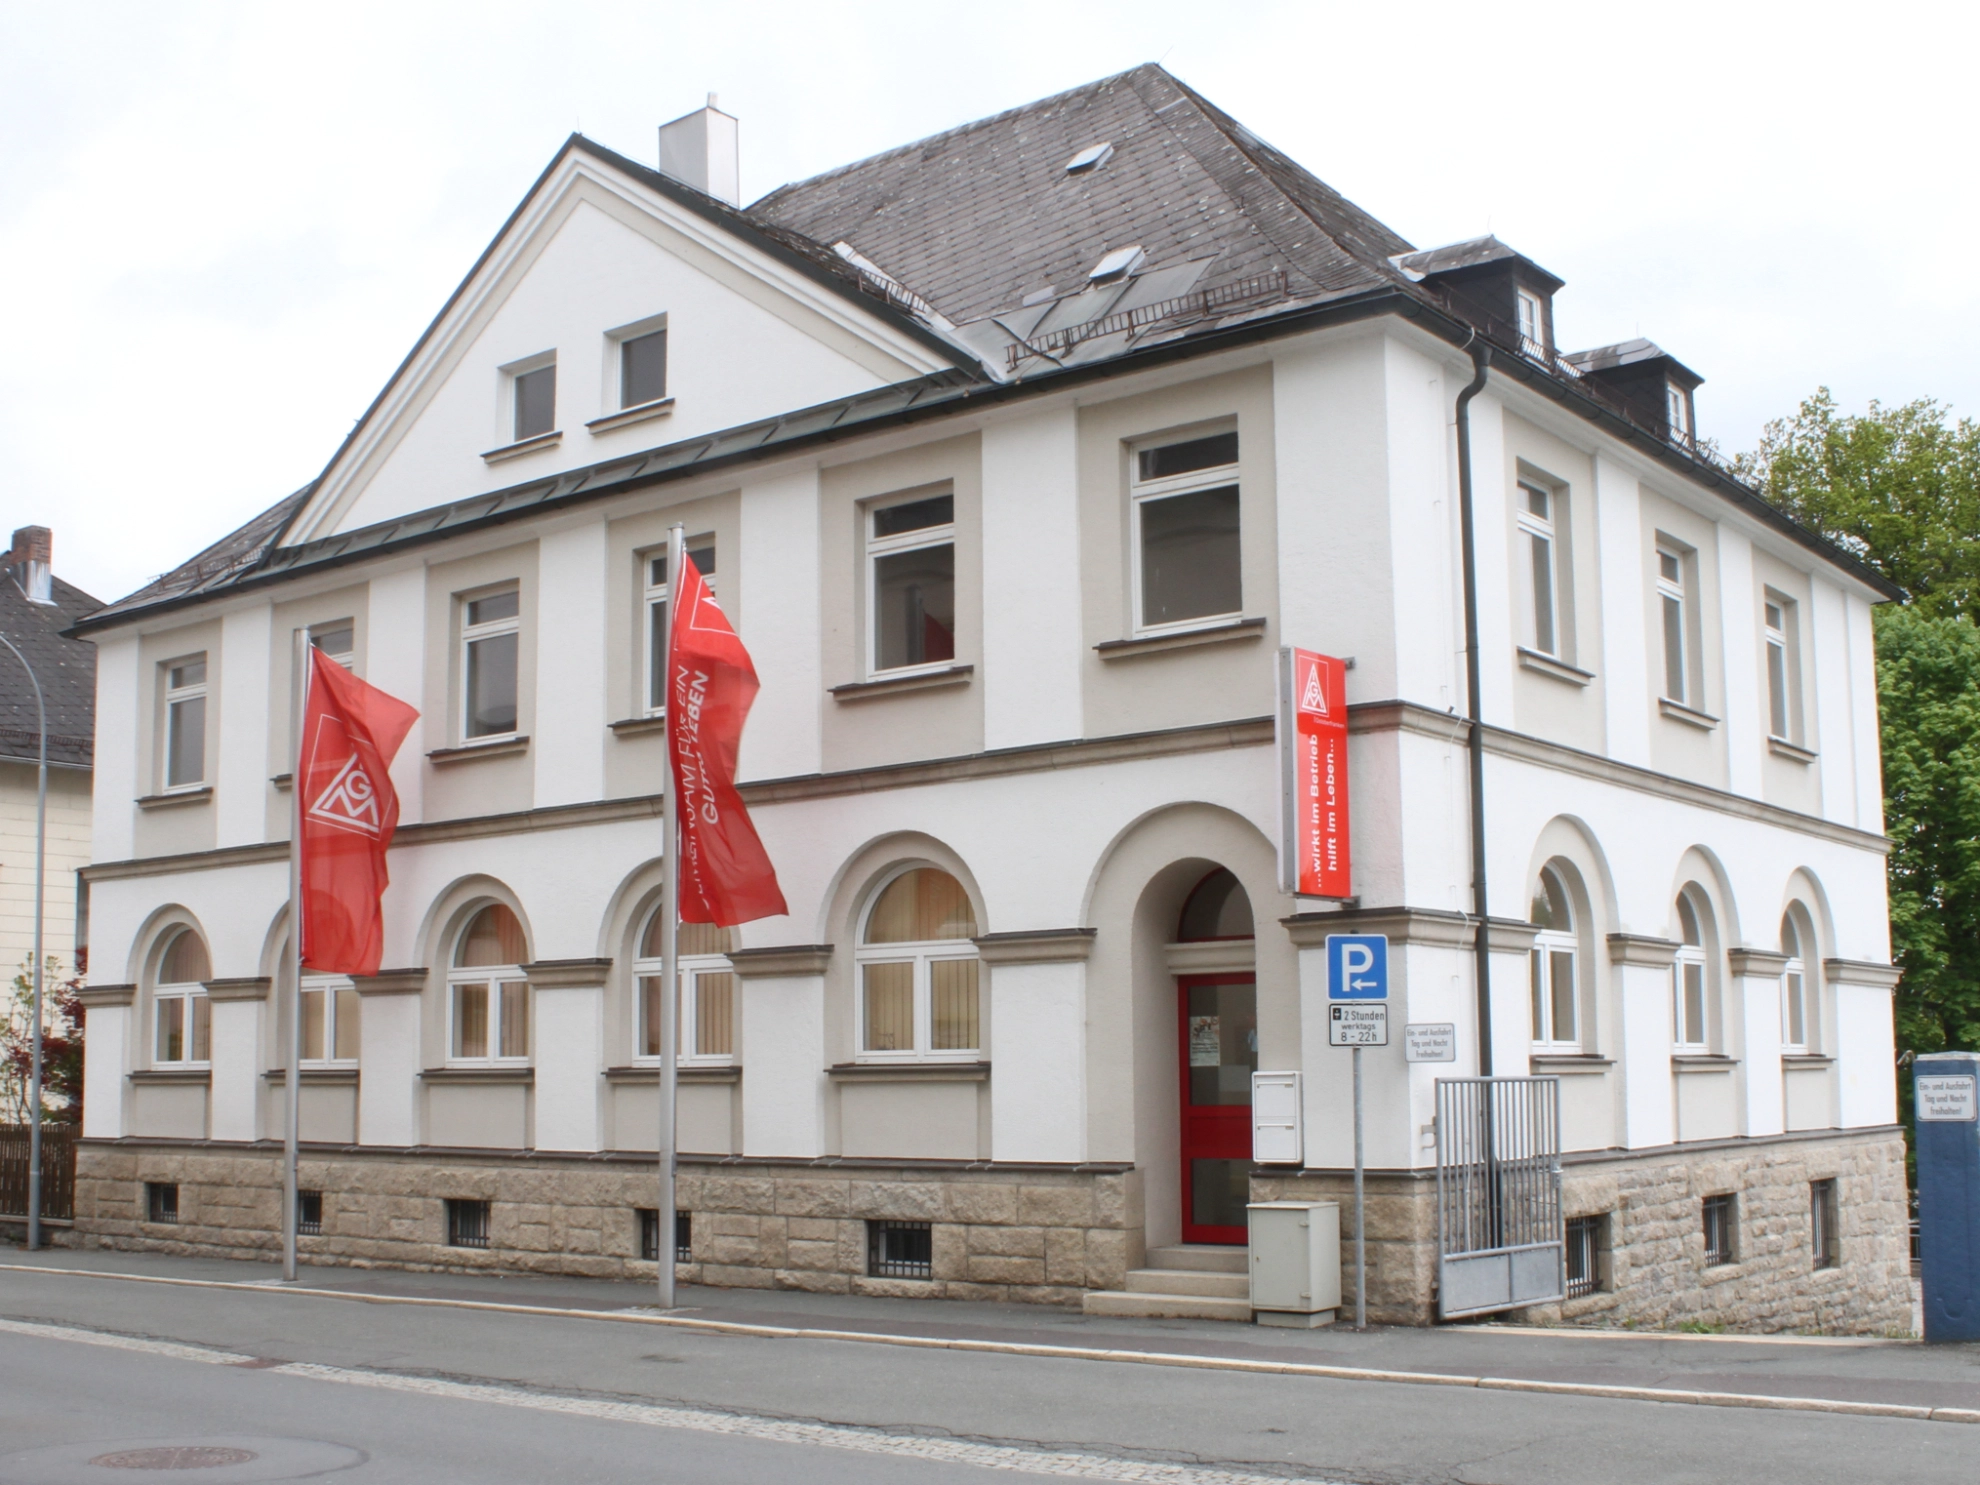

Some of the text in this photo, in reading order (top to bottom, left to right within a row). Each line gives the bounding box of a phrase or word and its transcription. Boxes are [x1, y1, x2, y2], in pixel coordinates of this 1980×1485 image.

[676, 665, 689, 707] EIN
[1309, 734, 1320, 797] Betrieb
[318, 760, 379, 828] GM
[1311, 803, 1320, 825] im
[1327, 811, 1336, 832] im
[1327, 837, 1337, 871] hilft
[1342, 944, 1374, 992] P
[1344, 1011, 1385, 1021] 2 Stunden
[1341, 1023, 1376, 1031] werktags
[1418, 1028, 1428, 1036] und
[1430, 1028, 1451, 1036] Ausfahrt
[1340, 1031, 1347, 1042] 8
[1411, 1039, 1420, 1049] Tag
[1421, 1039, 1431, 1047] und
[1919, 1081, 1971, 1090] Ein- und Ausfahrt
[1924, 1093, 1967, 1105] Tag und Nacht
